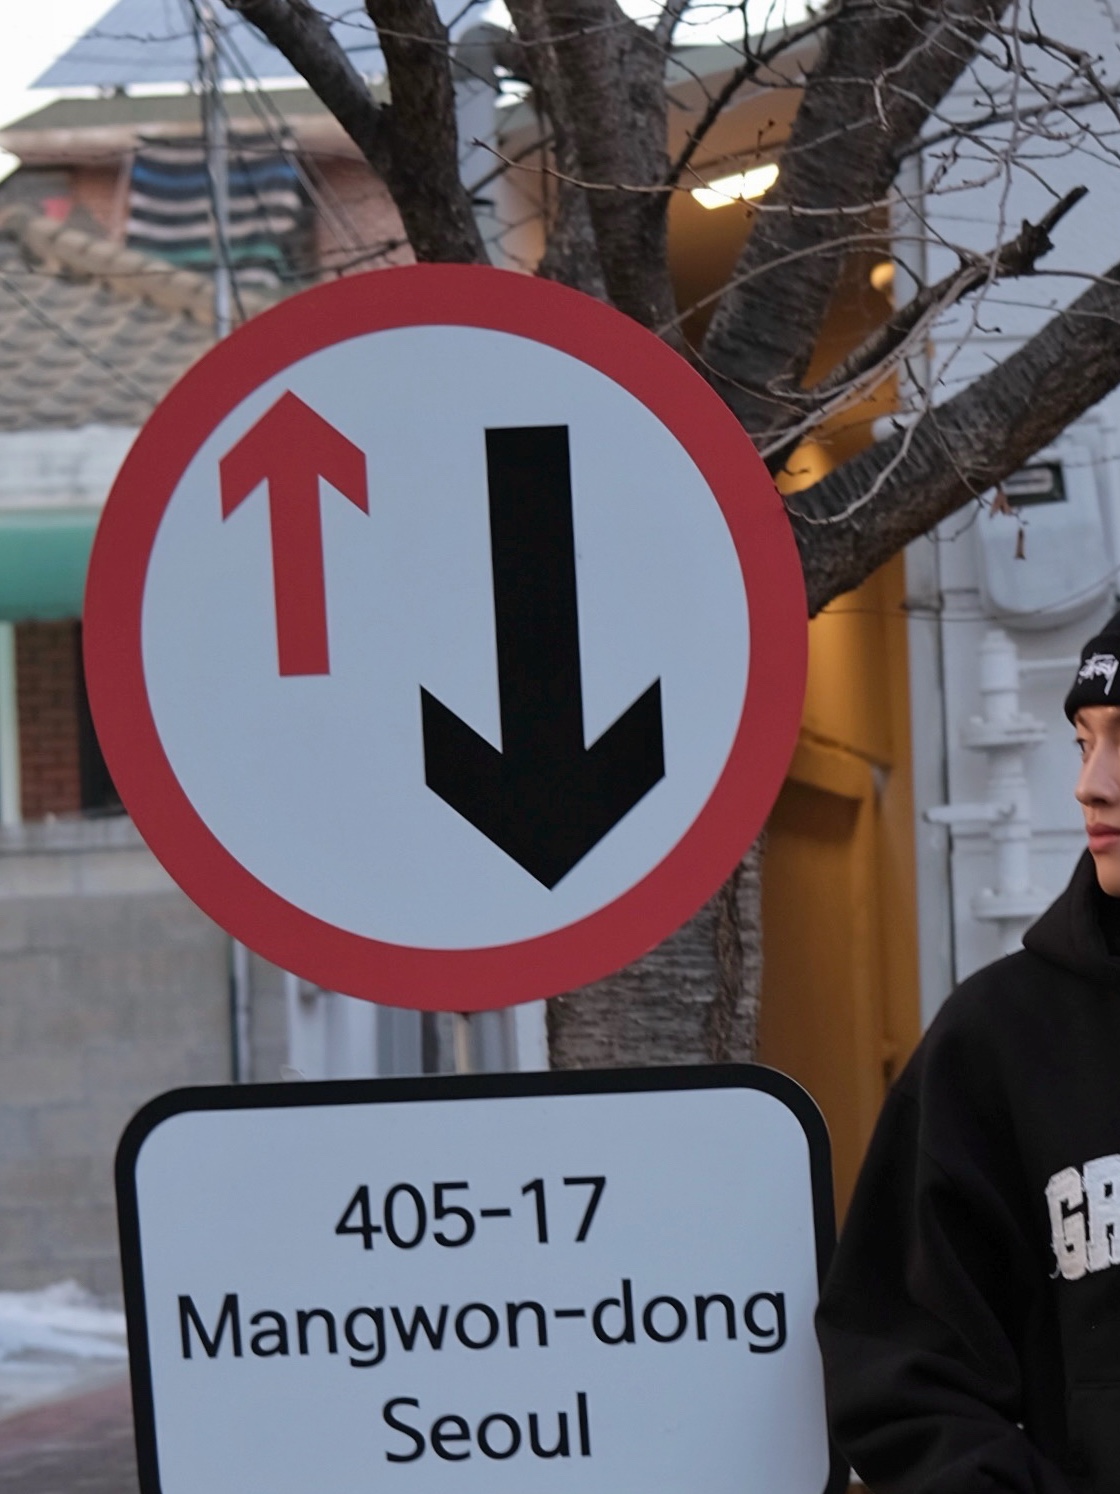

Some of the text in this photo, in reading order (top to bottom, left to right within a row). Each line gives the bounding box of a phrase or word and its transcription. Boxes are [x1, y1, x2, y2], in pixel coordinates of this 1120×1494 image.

[334, 1175, 608, 1251] 405-17
[177, 1278, 789, 1368] Mangwon-dong
[381, 1391, 593, 1464] Seoul
